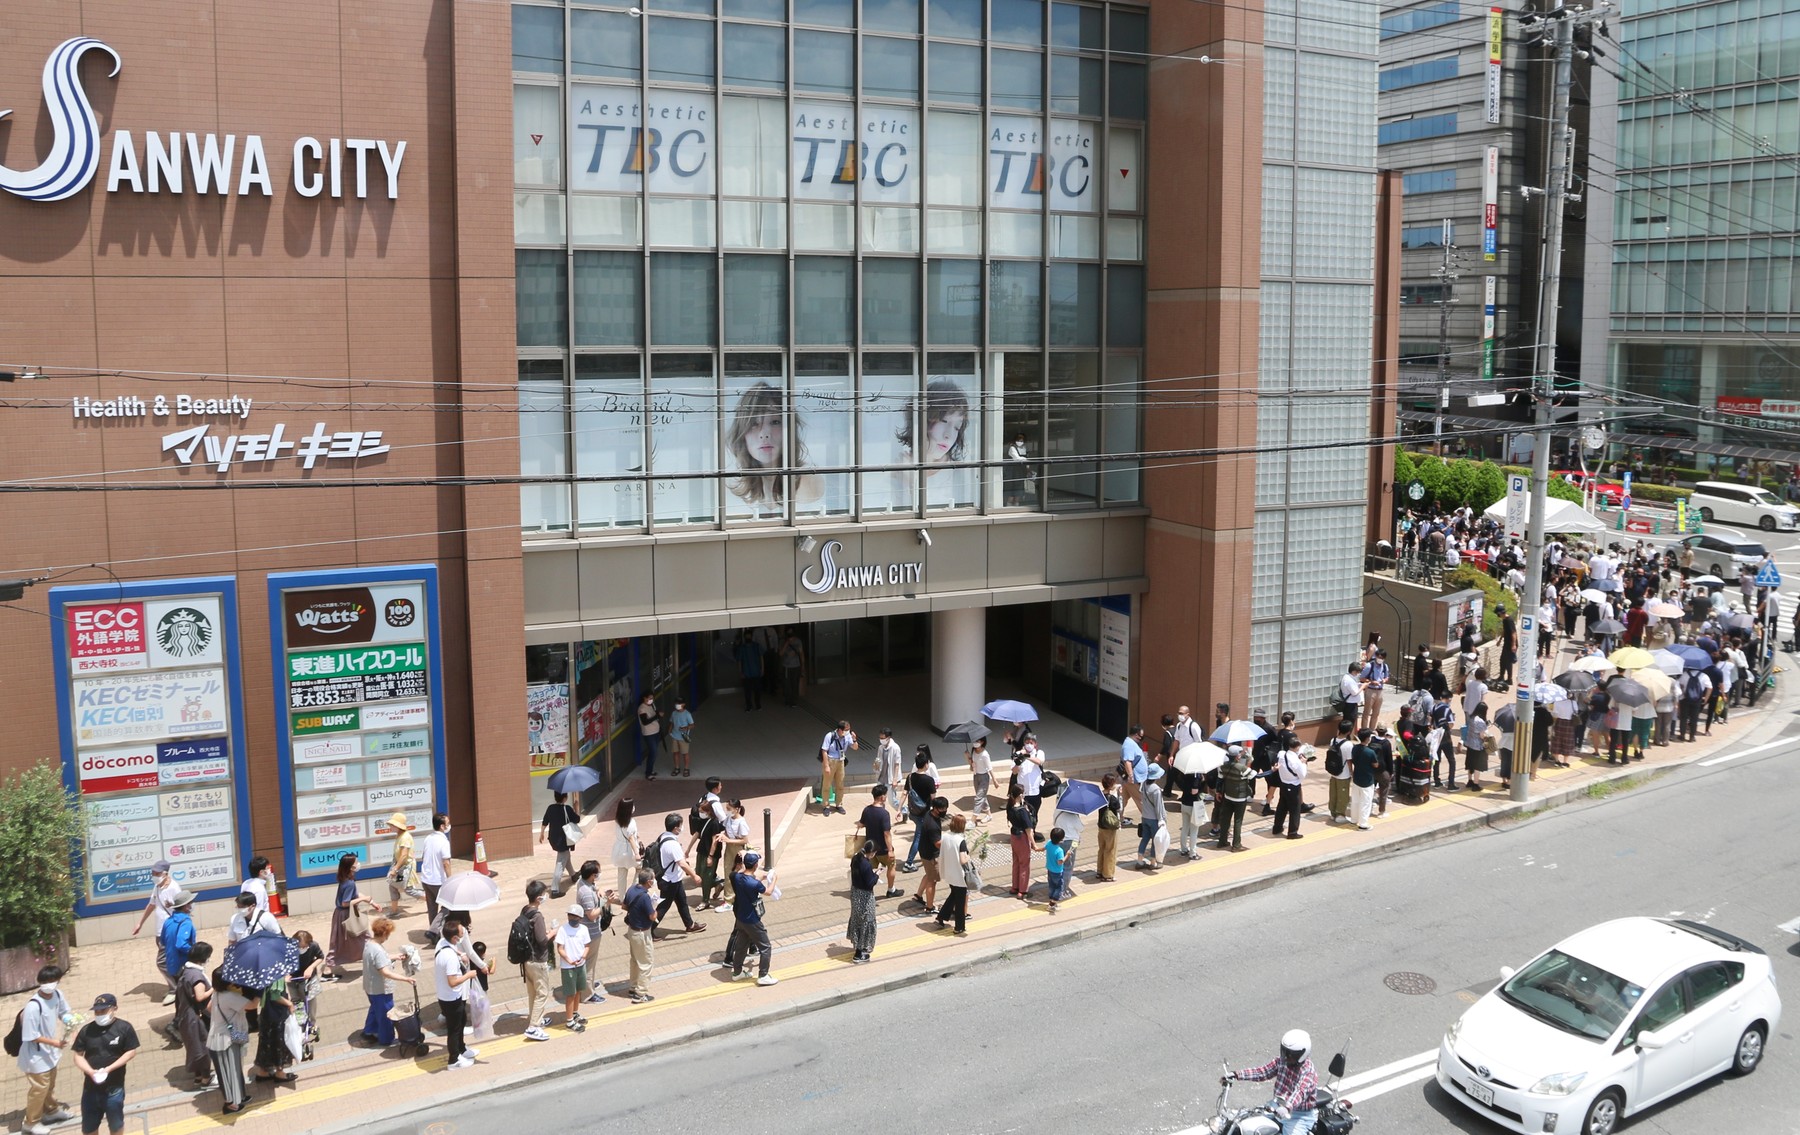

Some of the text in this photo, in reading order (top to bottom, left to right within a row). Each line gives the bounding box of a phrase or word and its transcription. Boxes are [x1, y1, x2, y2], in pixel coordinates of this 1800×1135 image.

[0, 36, 407, 201] SANWA CITY
[795, 113, 909, 135] Aestetic
[991, 127, 1091, 149] Aestetic
[577, 124, 707, 177] TBC
[793, 136, 908, 188] TBC
[990, 149, 1090, 198] TBC
[73, 395, 252, 419] Health & Beauty
[630, 413, 673, 426] new
[162, 423, 391, 472] マツモトキヨシ
[613, 481, 677, 493] CARNA
[1514, 479, 1521, 490] P
[801, 540, 923, 594] SANWA CITY
[389, 604, 411, 615] 100
[74, 607, 139, 631] ECC
[295, 609, 360, 627] Watts
[1522, 618, 1531, 628] P
[77, 629, 140, 646] 外語学院
[79, 659, 118, 670] 西大寺校
[291, 647, 423, 676] 東進ハイスクール
[78, 679, 221, 708] KECゼミナール
[81, 705, 164, 728] KEC個別
[295, 714, 355, 729] SUBWAY
[391, 731, 402, 739] 2F
[163, 746, 196, 758] ブルーム
[381, 739, 424, 751] 三井住友銀行
[82, 754, 155, 771] docomo
[127, 775, 157, 784] ドコモショップ
[183, 791, 222, 803] かなもり
[370, 788, 394, 803] girls
[183, 800, 223, 811] 耳鼻咽喉科
[319, 822, 362, 837] ツキムラ
[186, 840, 226, 854] 飯田眼科
[188, 866, 228, 879] まりん薬局
